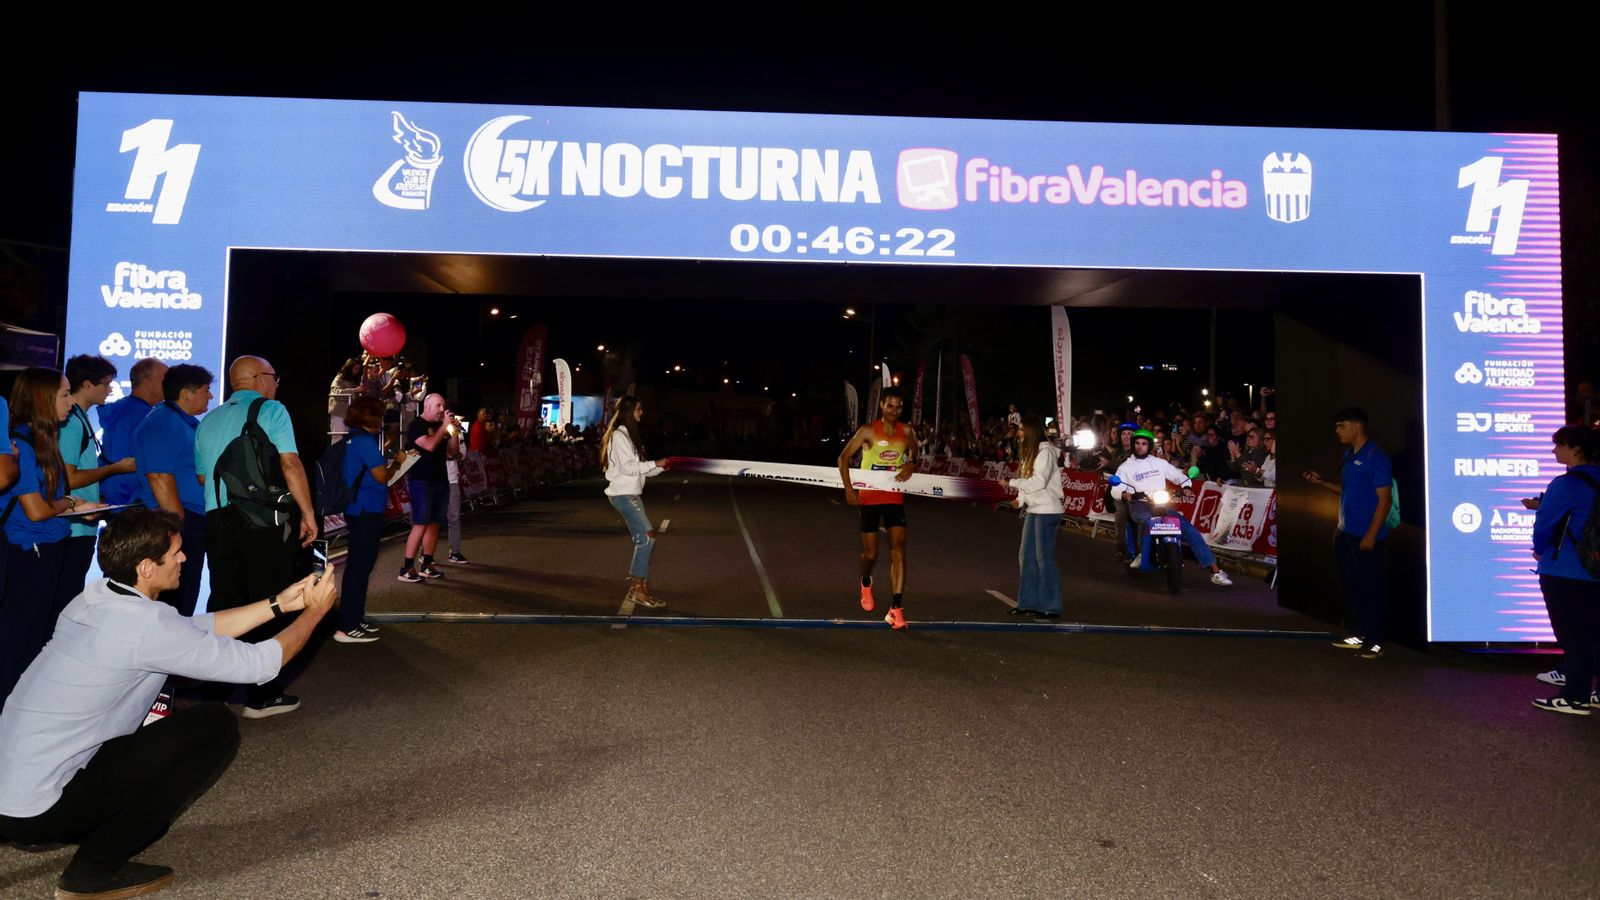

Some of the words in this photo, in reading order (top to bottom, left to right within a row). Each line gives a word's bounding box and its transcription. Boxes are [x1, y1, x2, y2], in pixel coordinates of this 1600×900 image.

[119, 119, 201, 224] 11
[562, 141, 882, 204] NOCTURNA
[1458, 156, 1530, 255] 11
[729, 223, 956, 257] 00:46:22
[100, 284, 202, 309] Valencia
[1453, 311, 1541, 333] Valencia
[134, 330, 192, 339] FUNDACIÓN
[134, 339, 193, 351] TRINIDAD
[133, 350, 192, 361] ALFONSO
[1484, 367, 1535, 378] TRINIDAD
[1484, 377, 1536, 387] ALFONSO
[1494, 423, 1535, 432] SPORTS
[152, 701, 168, 712] VIP
